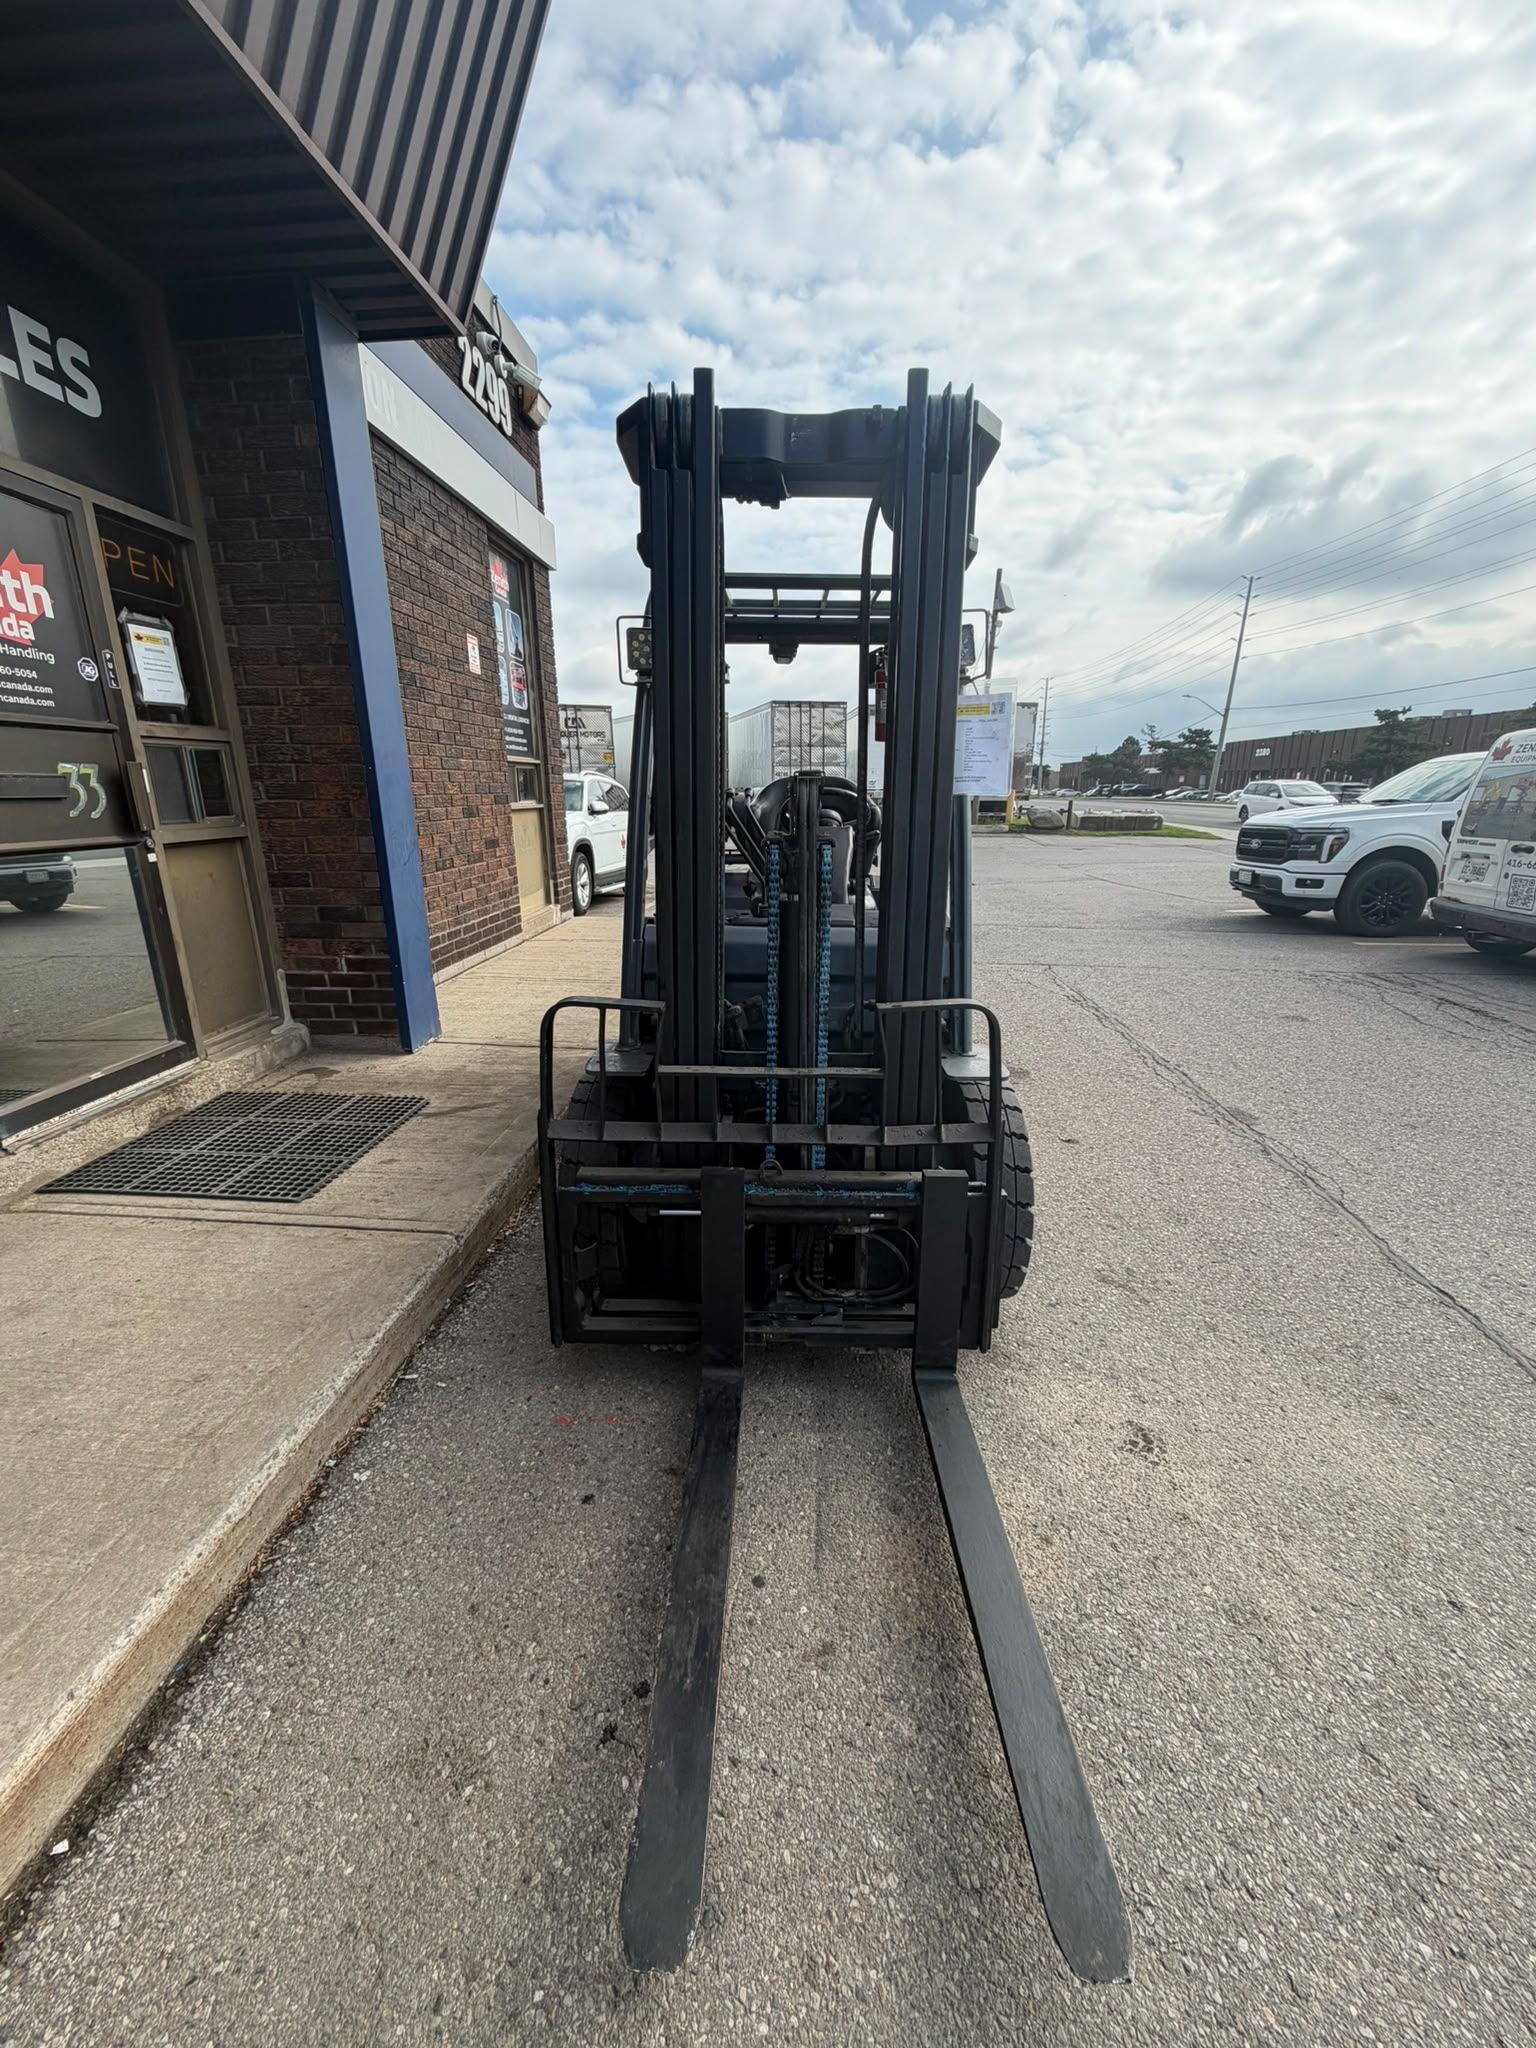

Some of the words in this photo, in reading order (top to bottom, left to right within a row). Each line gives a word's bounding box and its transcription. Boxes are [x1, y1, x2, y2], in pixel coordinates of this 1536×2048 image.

[457, 336, 513, 437] 2299
[101, 537, 174, 588] PEN
[0, 569, 54, 619] th
[0, 643, 55, 665] Handling
[104, 652, 118, 687] PULL
[1515, 742, 1536, 754] ZEN
